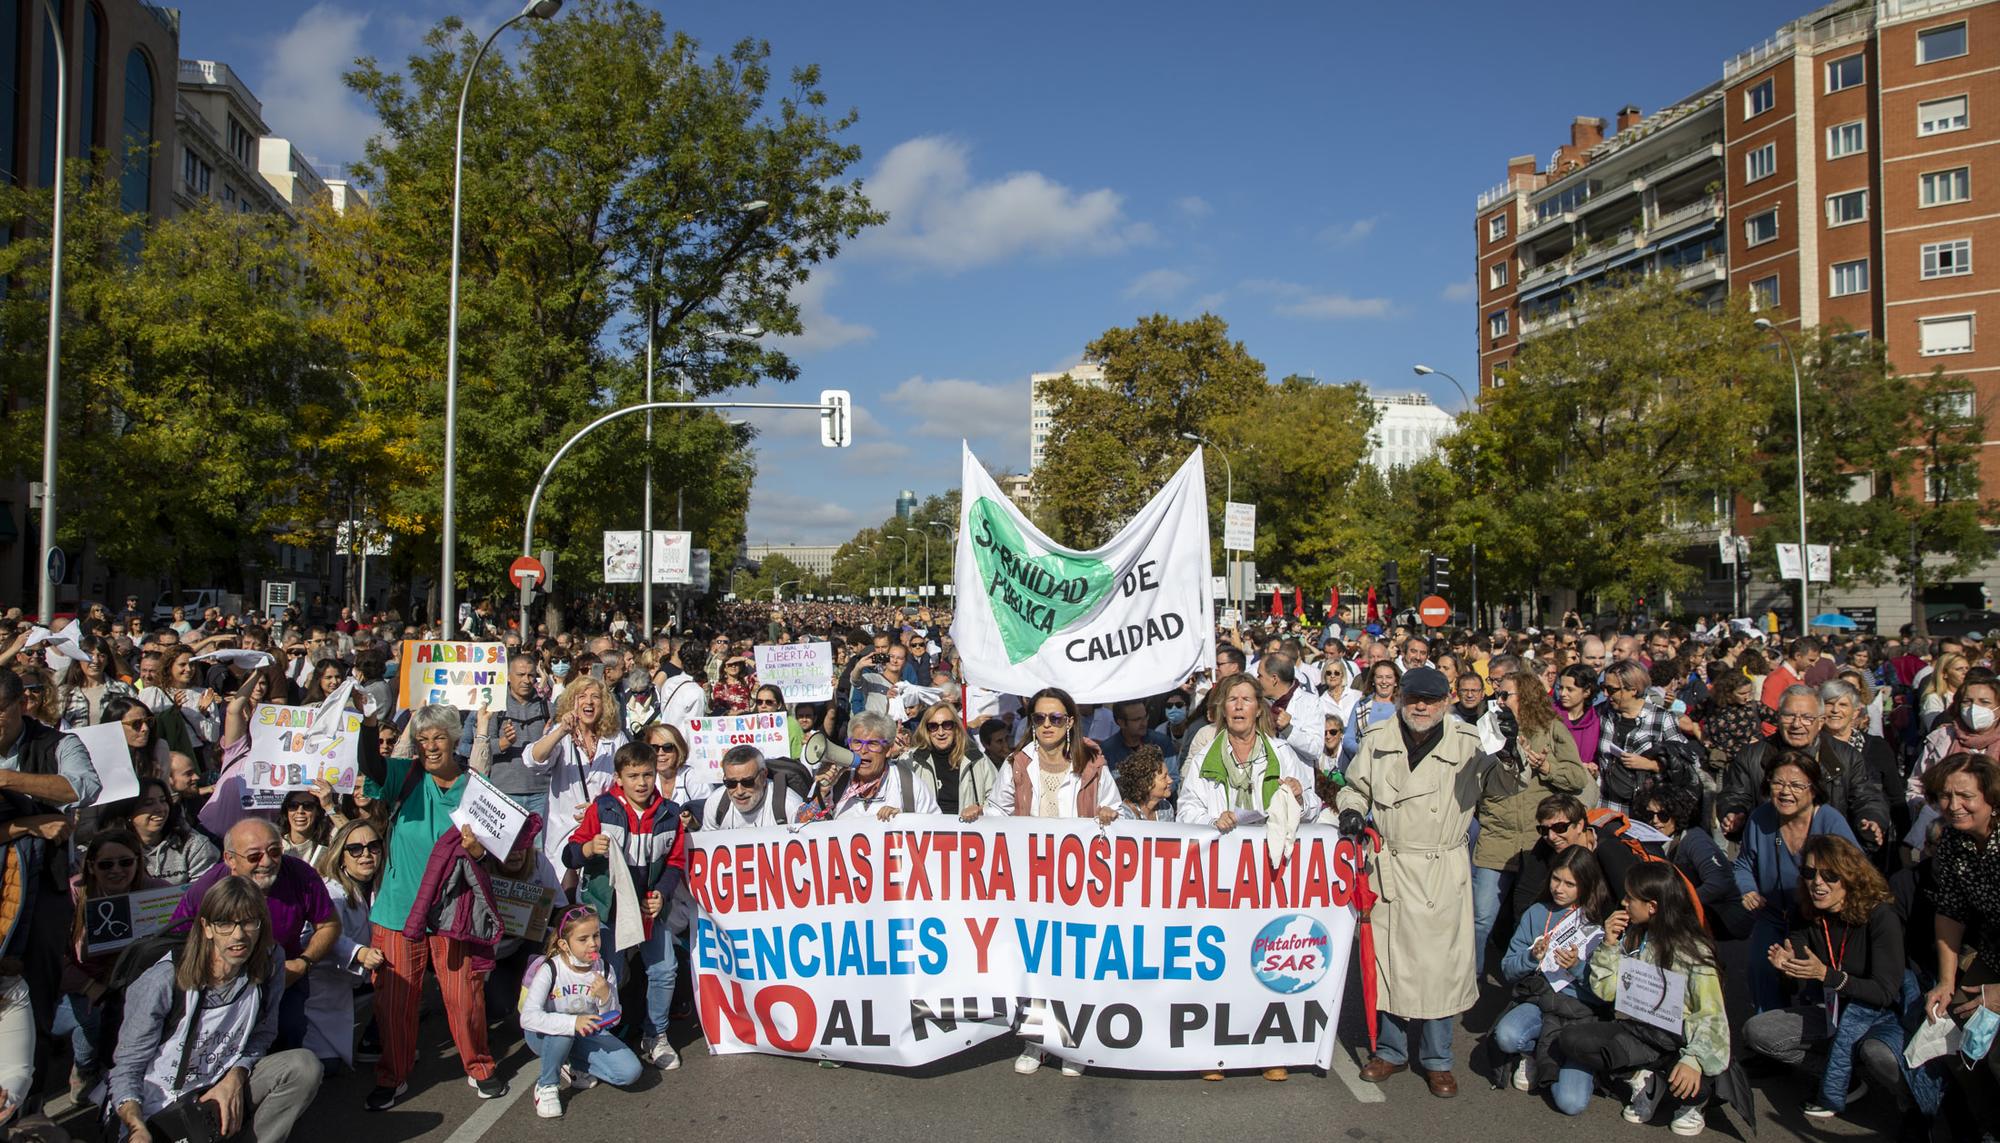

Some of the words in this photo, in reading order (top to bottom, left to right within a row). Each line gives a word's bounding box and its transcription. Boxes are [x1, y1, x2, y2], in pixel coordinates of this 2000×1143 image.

[1123, 560, 1159, 597] DE
[1065, 612, 1184, 663] CALIDAD
[417, 644, 485, 664] MADRID
[487, 646, 506, 663] SE
[767, 650, 817, 663] LIBERTAD
[423, 668, 505, 686] LEVANTA
[430, 688, 450, 704] EL
[467, 687, 493, 705] 13
[260, 706, 361, 732] SANID
[691, 719, 713, 731] UN
[252, 761, 354, 787] PUBLICA
[473, 800, 498, 826] PUBLICA
[479, 795, 506, 820] SANIDAD
[468, 807, 502, 839] UNIVERSAL
[883, 831, 1016, 901] EXTRA
[1028, 833, 1356, 909] HOSPITALARIAS
[697, 917, 948, 981] ESENCIALES
[963, 917, 1000, 973] Y
[1015, 918, 1227, 982] VITALES
[1254, 933, 1328, 953] Plataforma
[1263, 954, 1316, 972] SAR
[699, 974, 817, 1053] NO
[820, 999, 891, 1046] AL
[911, 996, 1143, 1049] NUEVO
